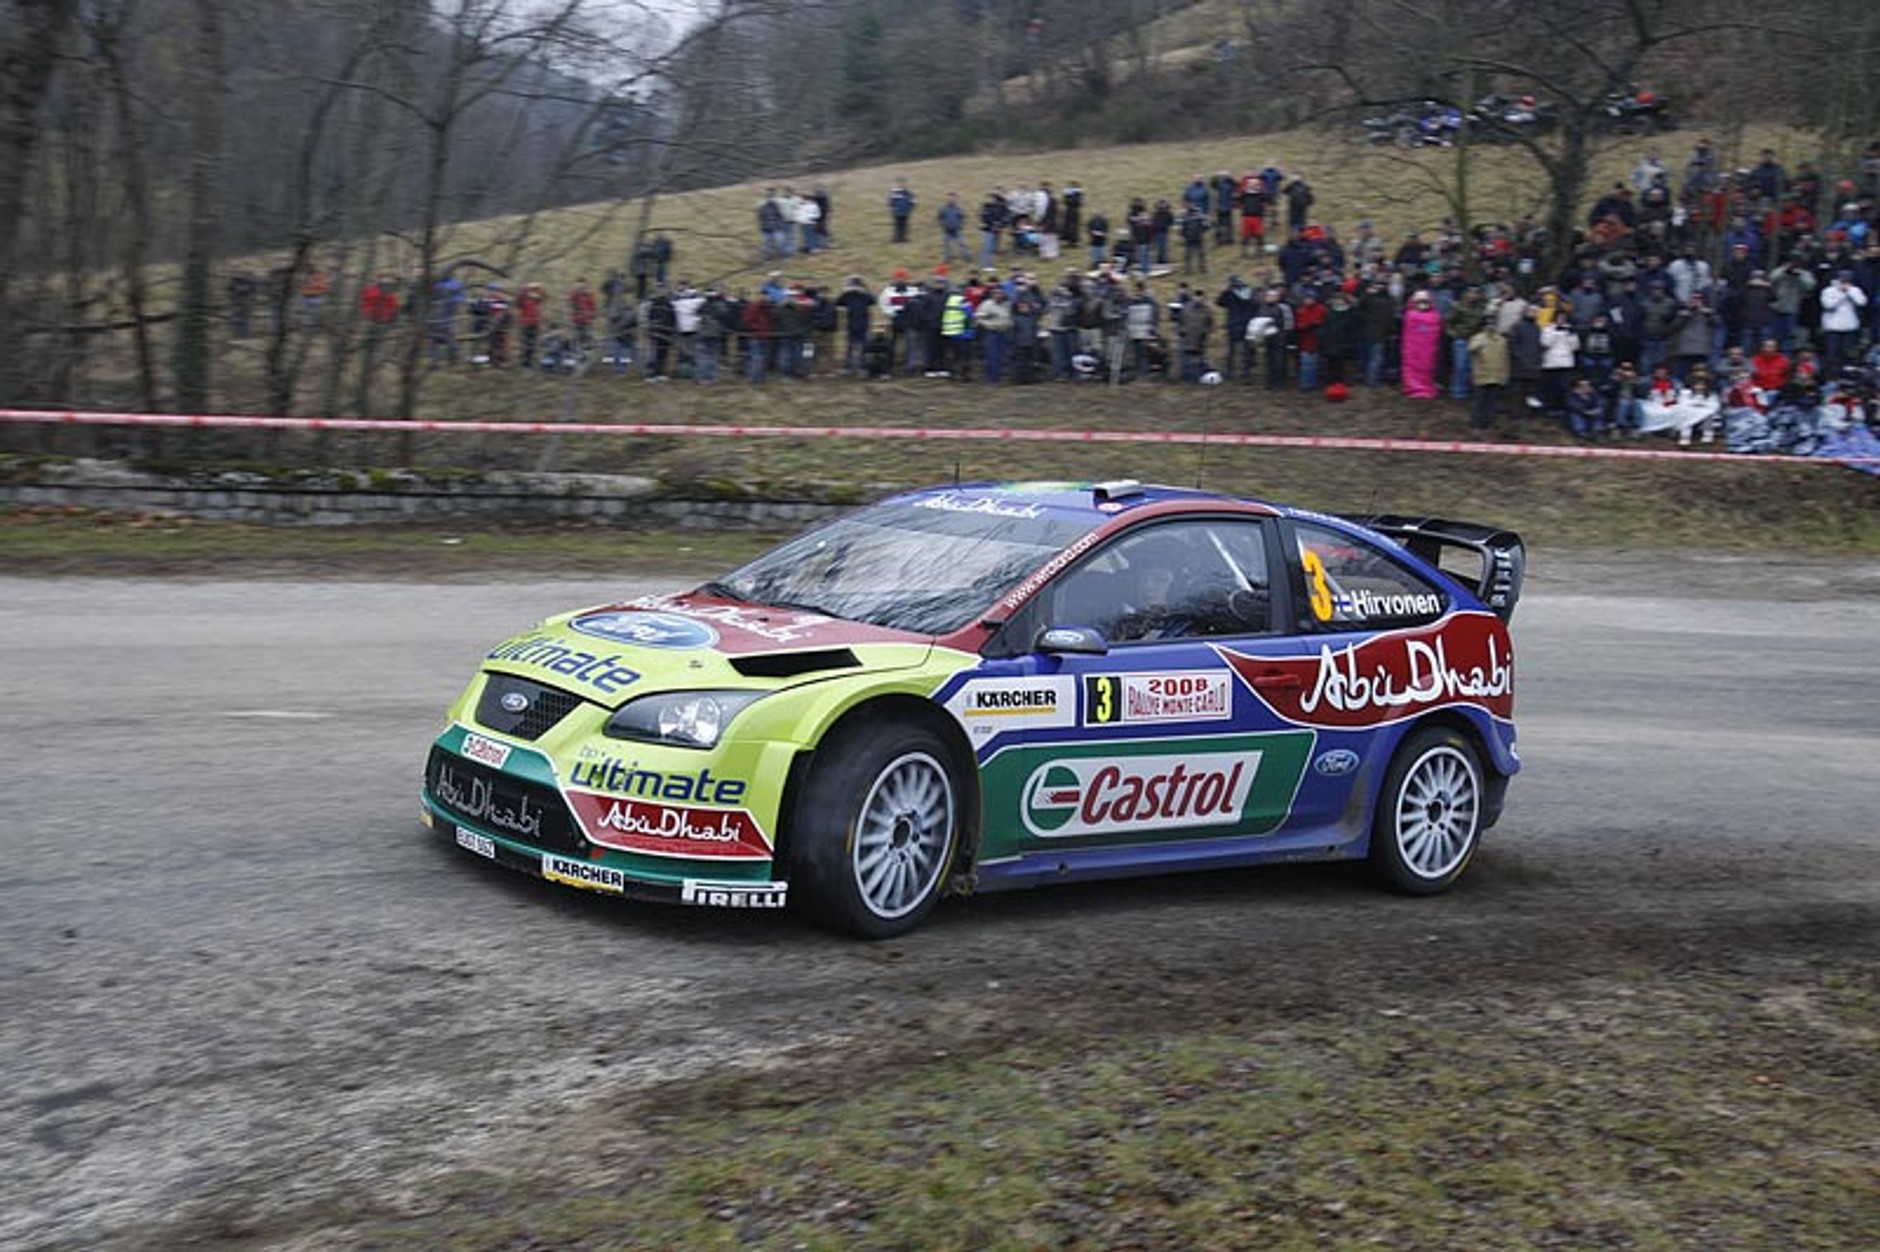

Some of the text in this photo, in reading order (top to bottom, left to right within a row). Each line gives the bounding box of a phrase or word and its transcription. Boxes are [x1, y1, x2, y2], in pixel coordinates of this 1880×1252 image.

[1303, 550, 1333, 621] 3
[1351, 590, 1441, 619] Hirvonen
[1096, 676, 1112, 722] 3
[1148, 678, 1208, 697] 2008
[569, 757, 747, 804] ultimate
[1081, 760, 1245, 825] Castrol
[683, 878, 788, 908] PIRELLI
